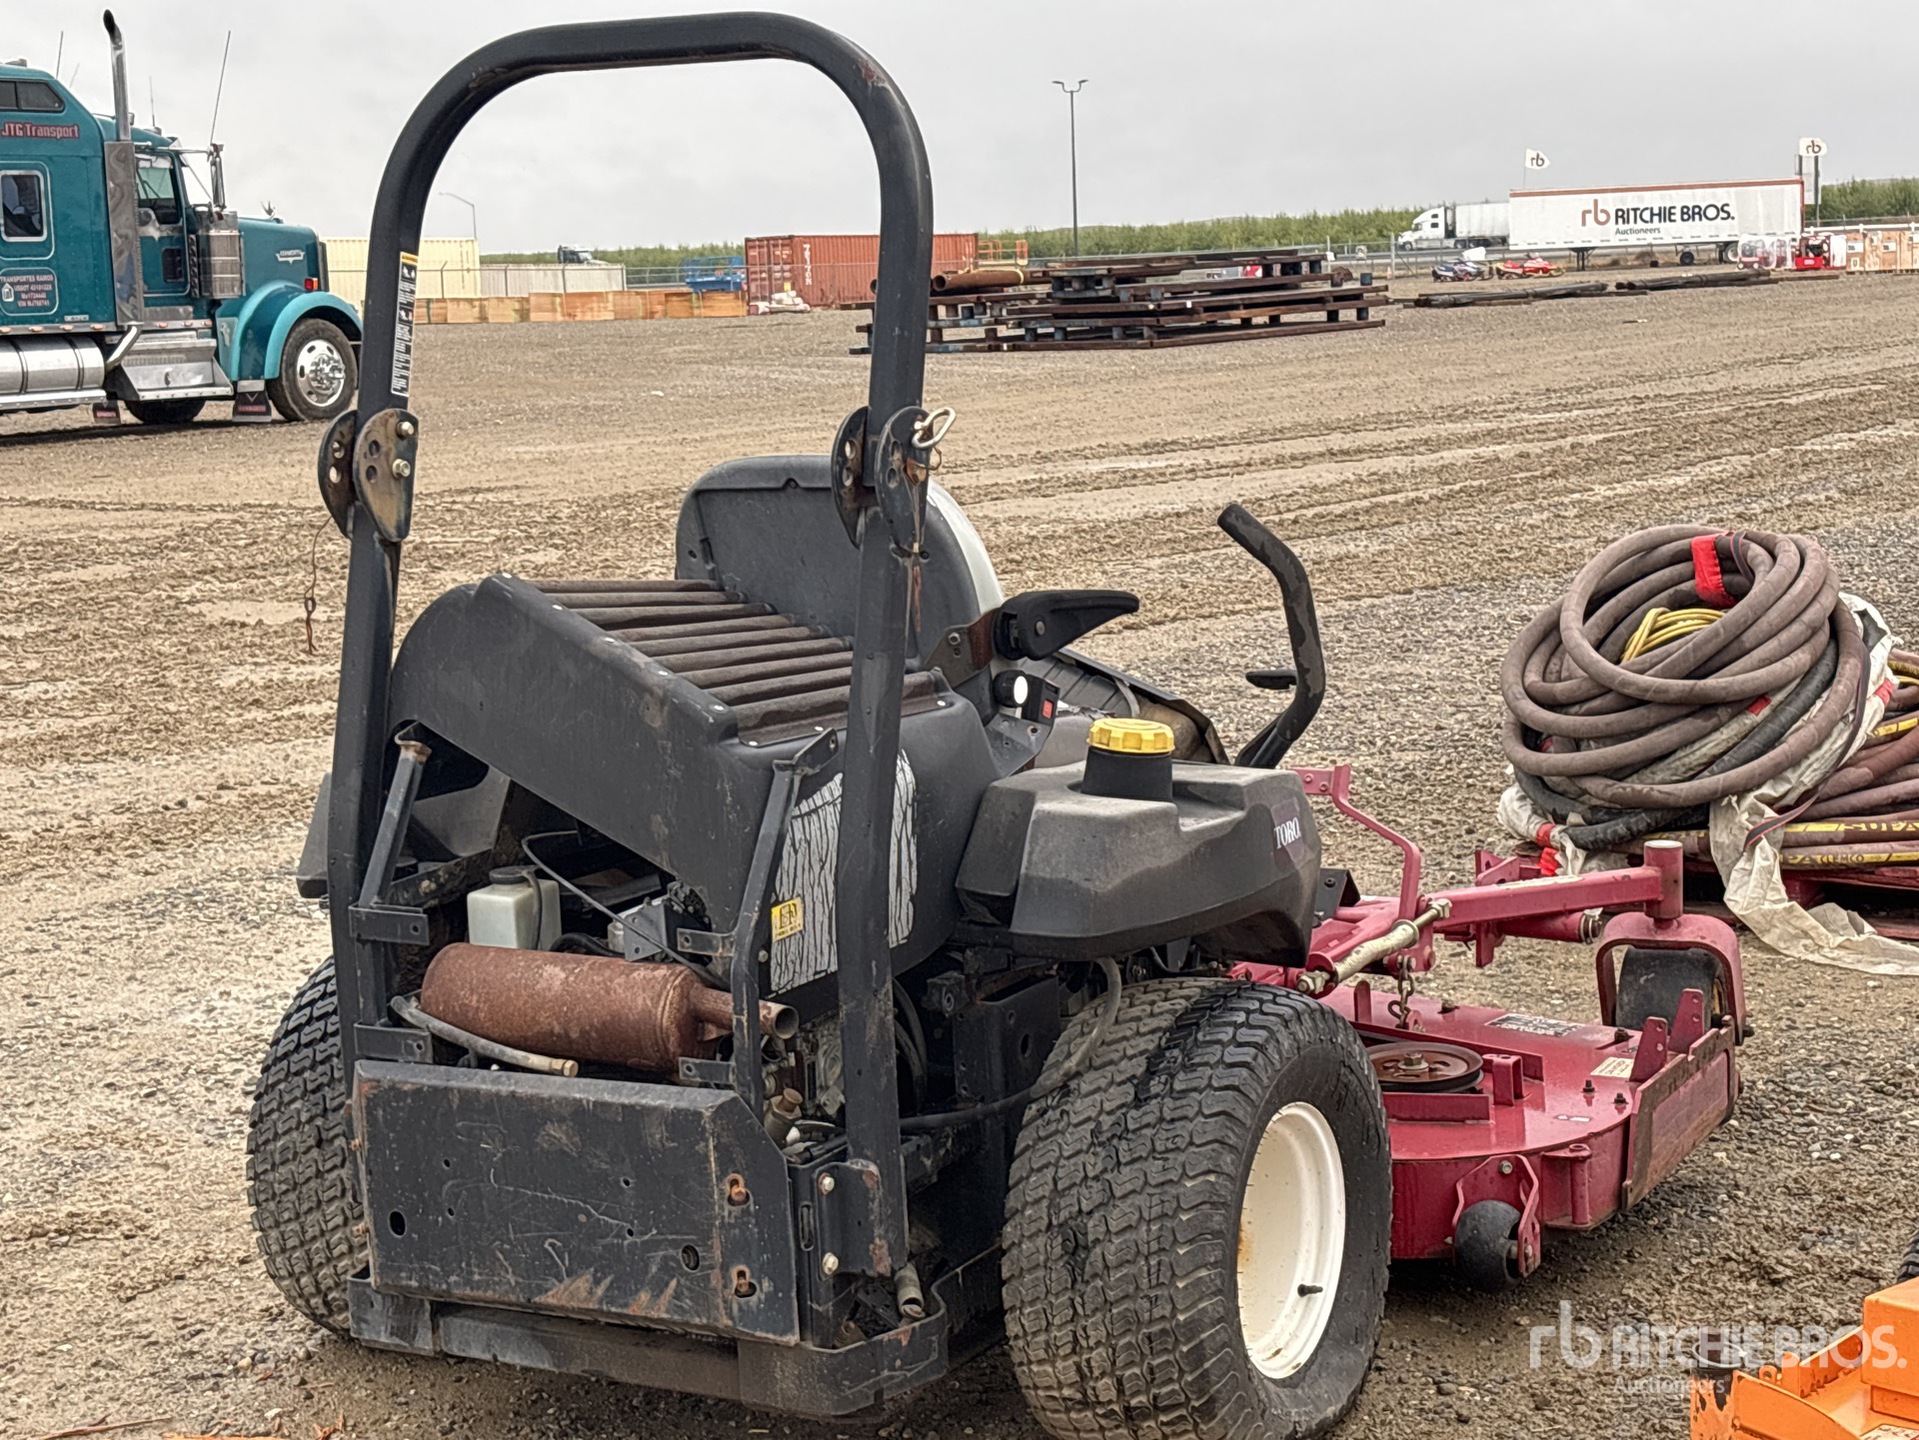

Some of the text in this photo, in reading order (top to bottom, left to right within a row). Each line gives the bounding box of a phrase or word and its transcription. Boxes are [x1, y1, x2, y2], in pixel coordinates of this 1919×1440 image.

[2, 122, 79, 140] JTG Transport
[1806, 139, 1822, 154] rb
[1530, 151, 1545, 167] rb
[1581, 198, 1736, 227] rb RITCHIE BROS.
[1614, 226, 1662, 236] Auctioneers
[1274, 817, 1301, 850] TORO
